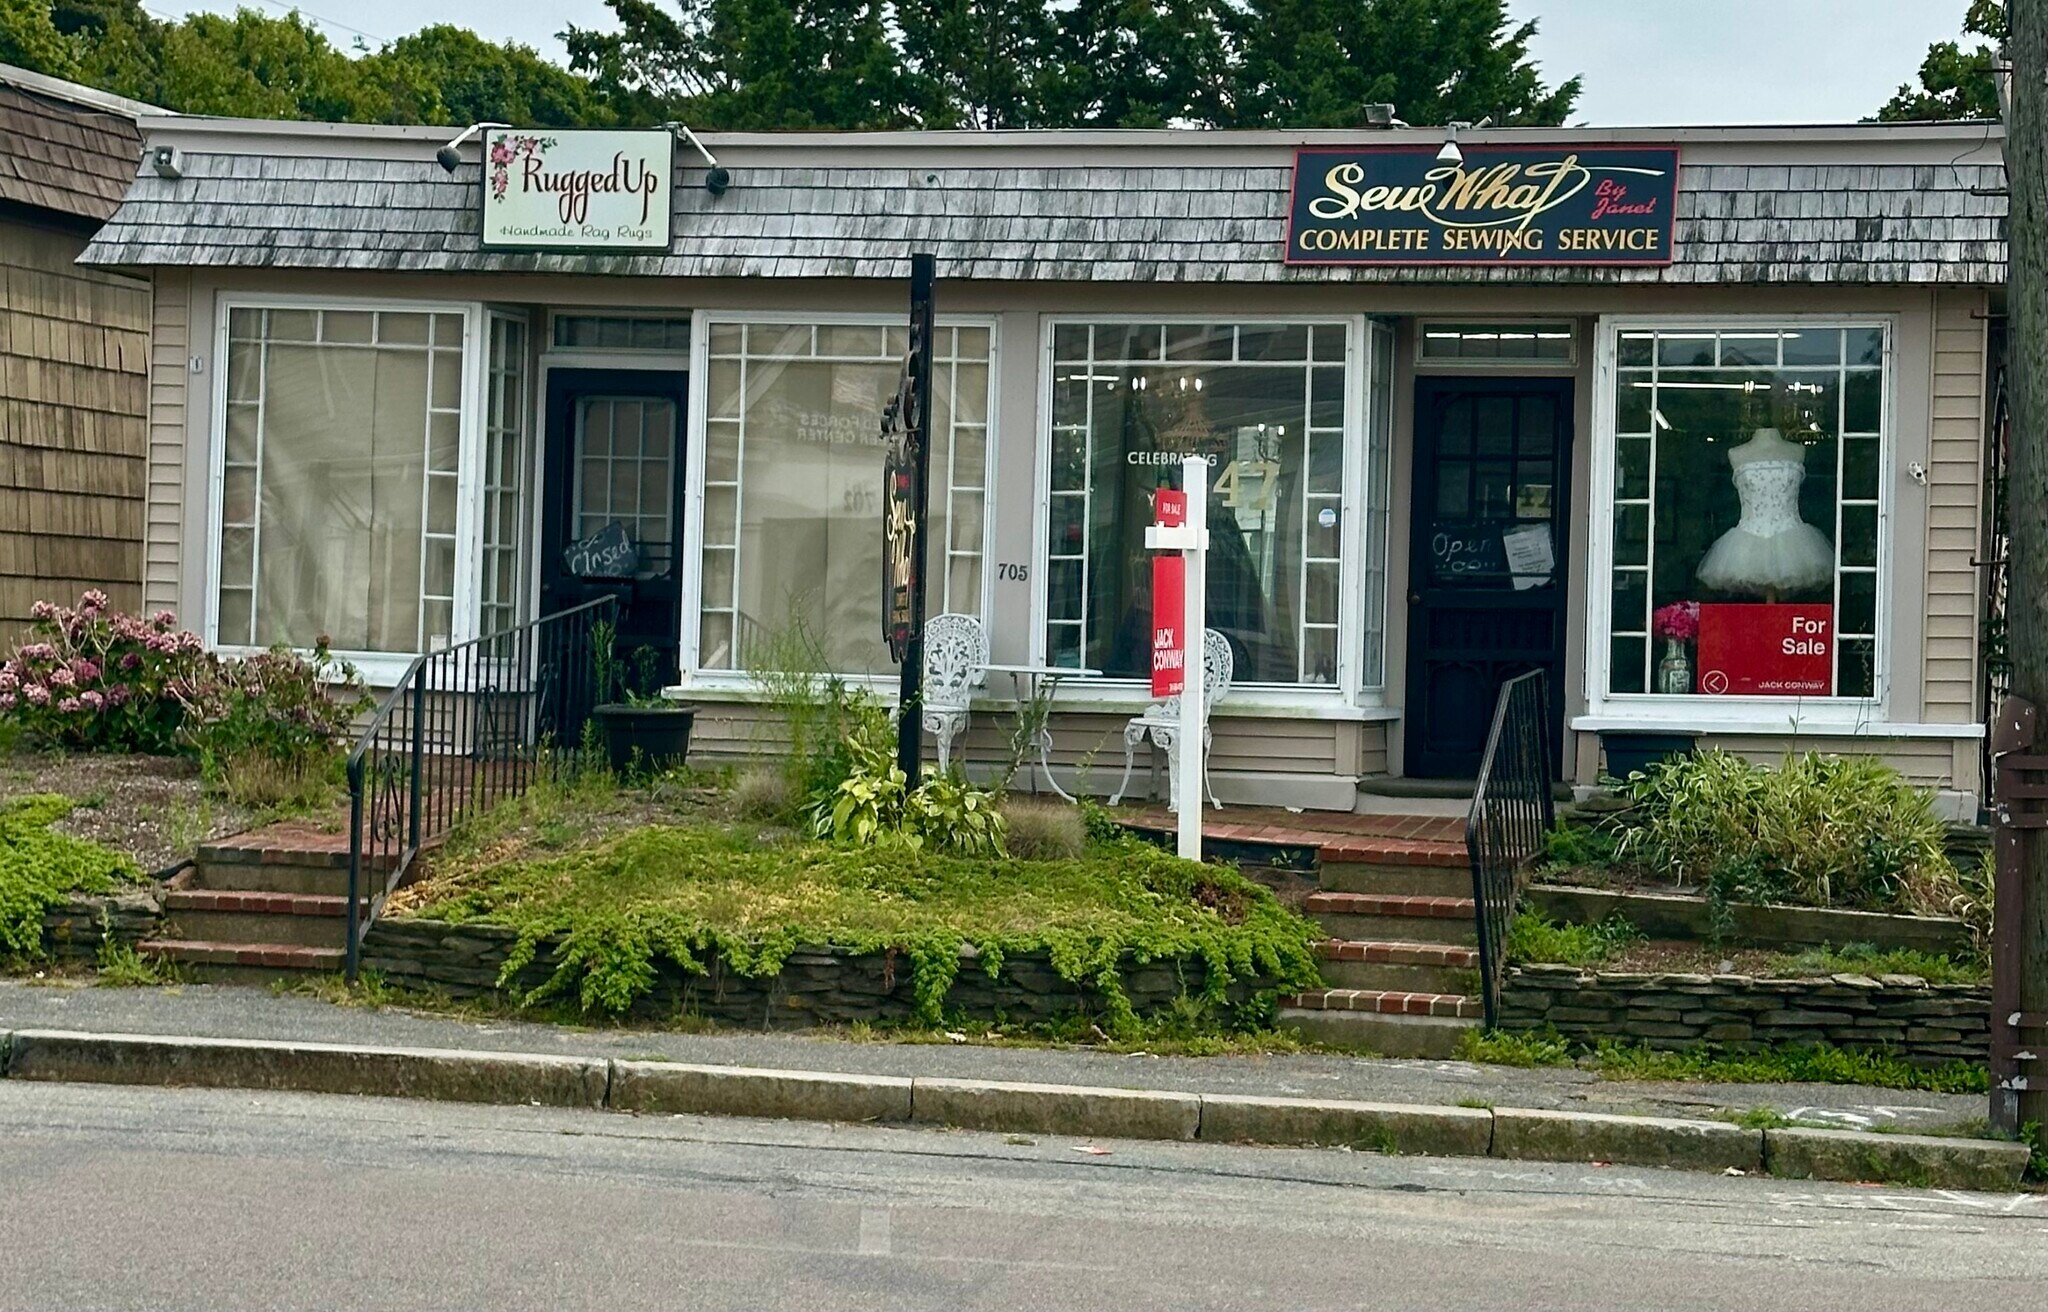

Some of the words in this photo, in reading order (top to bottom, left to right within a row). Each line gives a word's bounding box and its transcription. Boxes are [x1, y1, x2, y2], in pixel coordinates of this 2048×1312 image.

[1595, 179, 1627, 202] By
[1591, 197, 1657, 220] Janet
[499, 225, 575, 237] Handmade
[581, 226, 610, 240] Rag
[617, 226, 653, 240] Rugs
[1299, 229, 1429, 251] COMPLETE
[1442, 229, 1543, 251] SEWING
[1558, 228, 1659, 250] SERVICE
[1213, 460, 1280, 510] 47
[1432, 533, 1492, 562] Open
[998, 563, 1028, 581] 705
[1792, 616, 1826, 634] For
[1154, 628, 1174, 649] JACK
[1782, 637, 1826, 655] Sale
[1153, 649, 1184, 671] CONWAY
[1758, 681, 1783, 689] JACK
[1784, 681, 1825, 690] CONWAY
